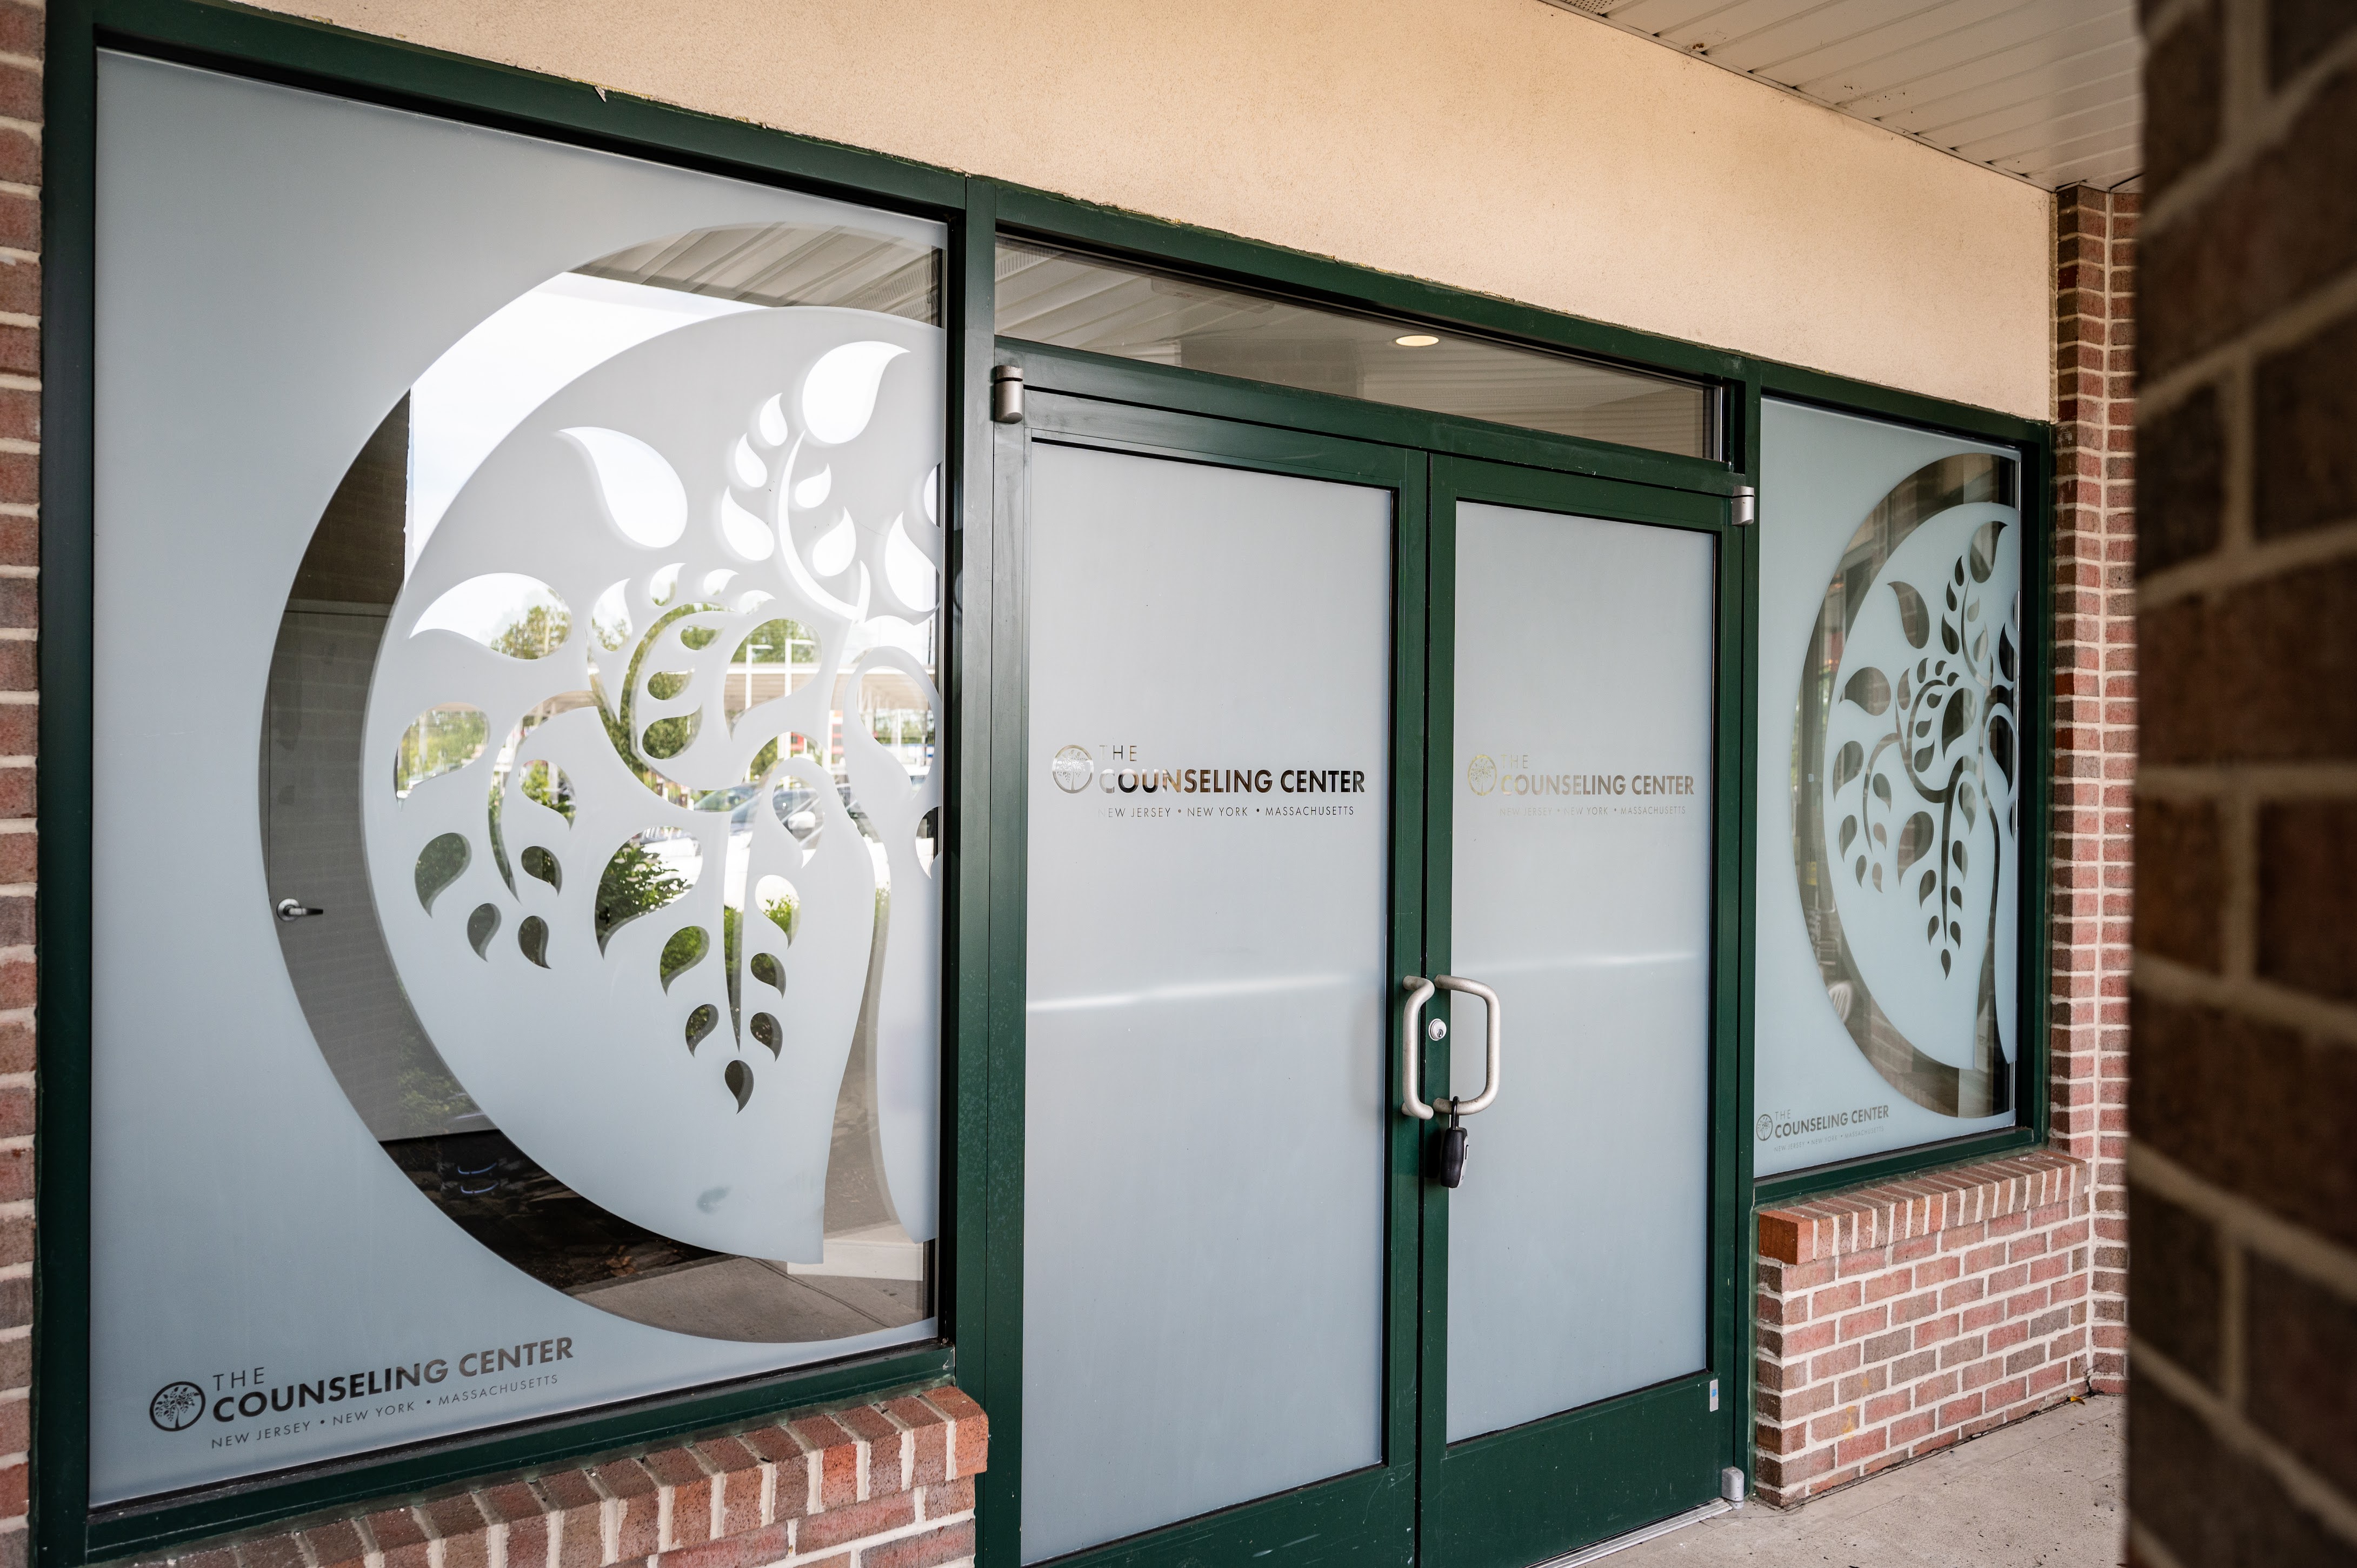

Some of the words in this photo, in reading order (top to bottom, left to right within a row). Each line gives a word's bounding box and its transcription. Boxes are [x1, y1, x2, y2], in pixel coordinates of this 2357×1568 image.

[1100, 745, 1137, 761] THE
[1501, 755, 1528, 769] THE
[1099, 769, 1273, 793] COUNSELING
[1280, 770, 1365, 792] CENTER
[1501, 775, 1626, 796] COUNSELING
[1632, 775, 1694, 795] CENTER
[1131, 808, 1170, 817] JERSEY
[1187, 808, 1215, 816] NEW
[1219, 807, 1248, 816] YORK
[1266, 806, 1354, 816] MASSACHUSETTS
[1524, 808, 1552, 816] JERSEY
[1620, 806, 1685, 815] MASSACHUSETTS
[1775, 1110, 1790, 1120] THE
[1775, 1112, 1848, 1138] COUNSELING
[1852, 1105, 1889, 1124] CENTER
[1788, 1142, 1805, 1150] JERSEY
[1845, 1126, 1884, 1138] MASSACHUSETTS
[214, 1367, 265, 1391] THE
[214, 1359, 448, 1423] COUNSELING
[458, 1337, 574, 1377] CENTER
[212, 1434, 249, 1449] NEW
[256, 1420, 310, 1441] JERSEY
[333, 1410, 368, 1425] NEW
[376, 1402, 414, 1418] YORK
[438, 1374, 558, 1405] MASSACHUSETTS
